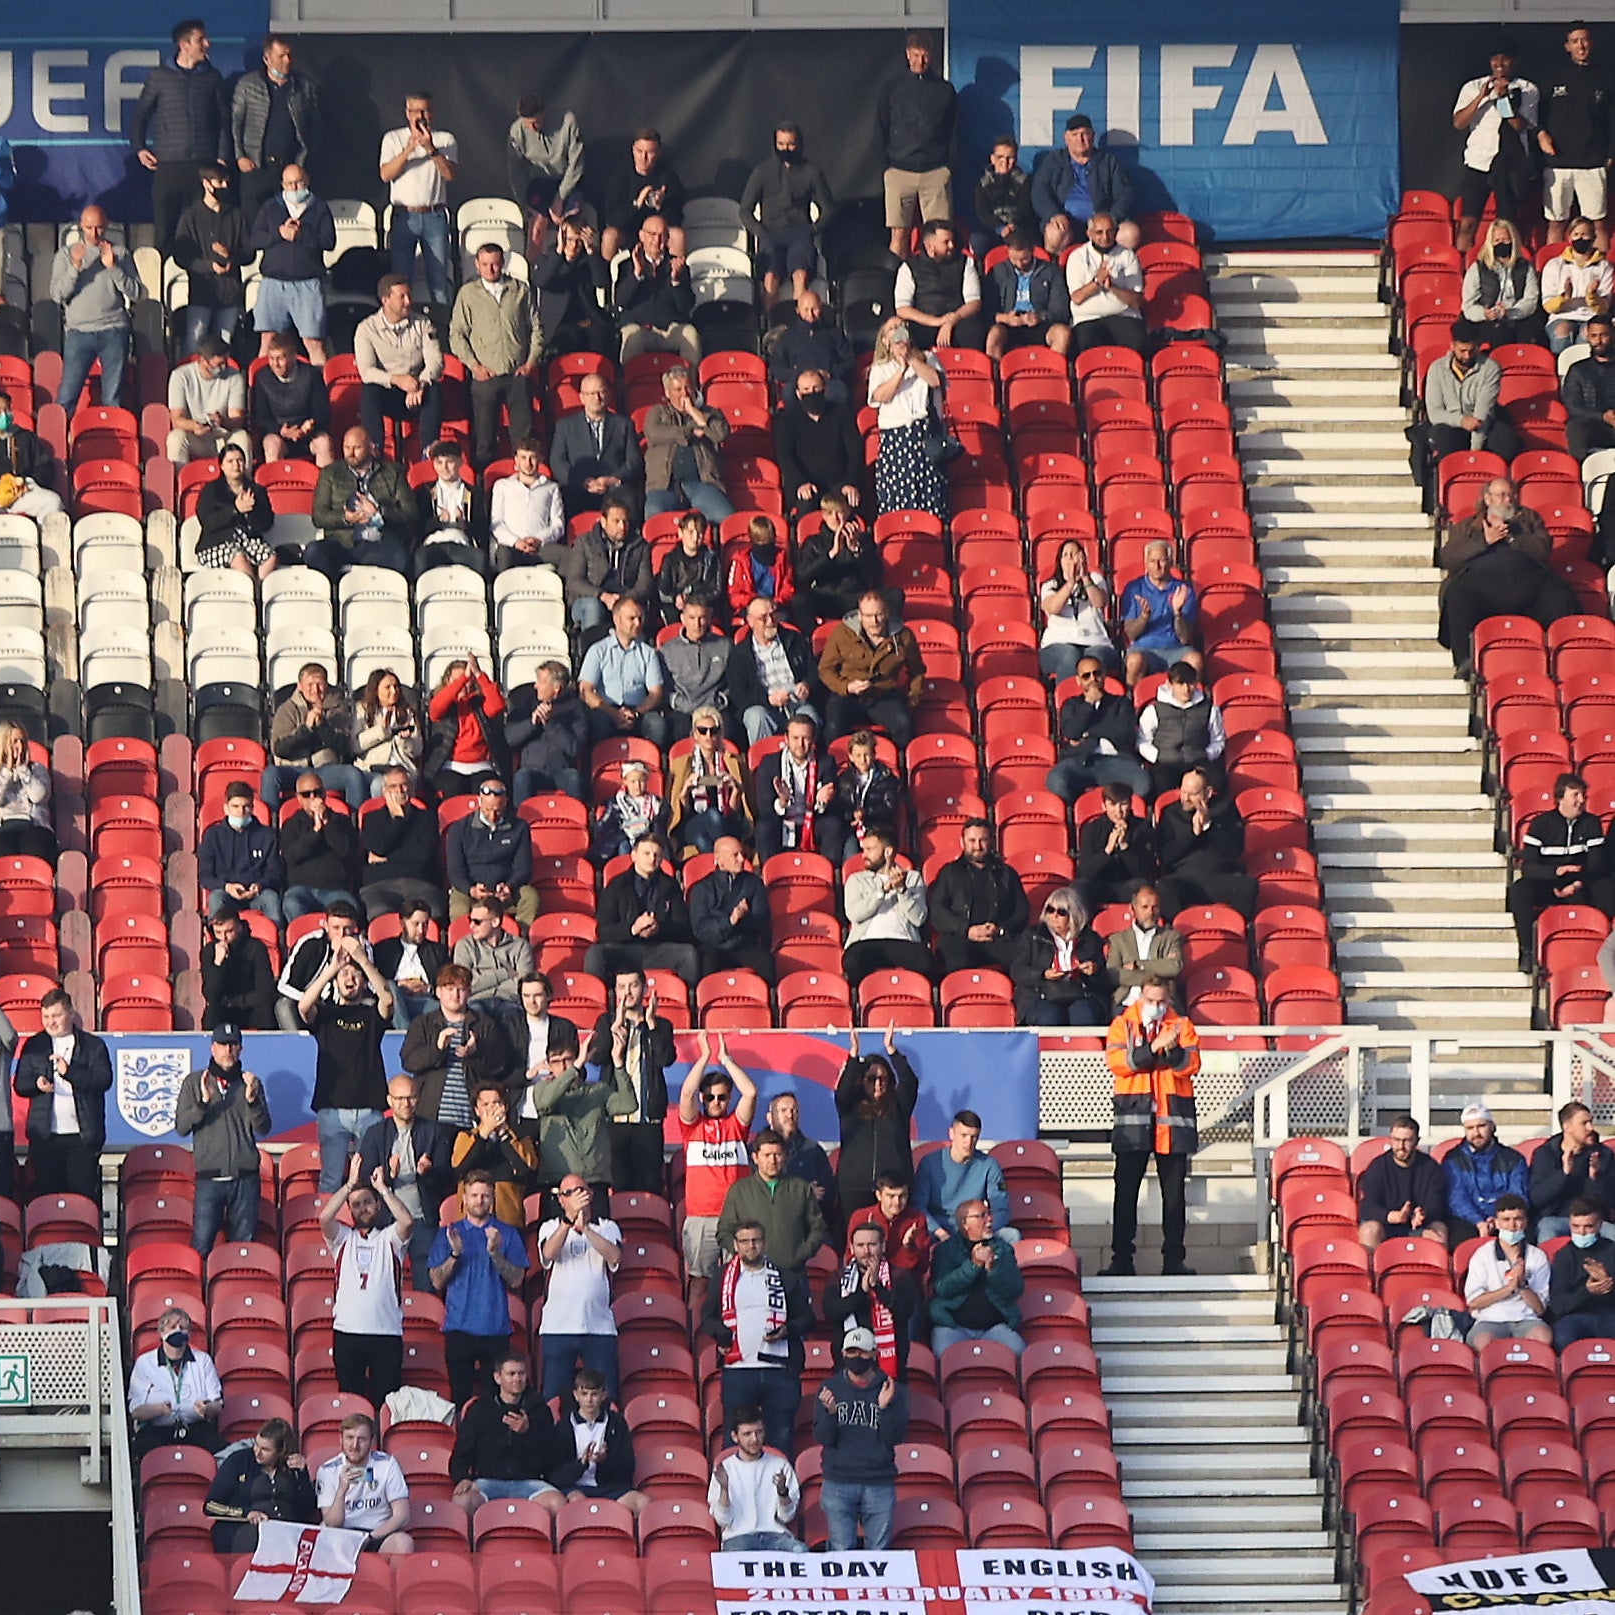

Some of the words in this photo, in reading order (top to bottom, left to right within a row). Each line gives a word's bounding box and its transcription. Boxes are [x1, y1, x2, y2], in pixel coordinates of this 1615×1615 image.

[1019, 44, 1329, 146] FIFA
[359, 1273, 369, 1290] 7
[739, 1561, 808, 1578] THE
[821, 1561, 888, 1578] DAY
[982, 1559, 1138, 1581] ENGLISH
[1437, 1562, 1569, 1590] NUFC
[747, 1587, 836, 1601] 20th
[847, 1586, 1034, 1601] FEBRUARY
